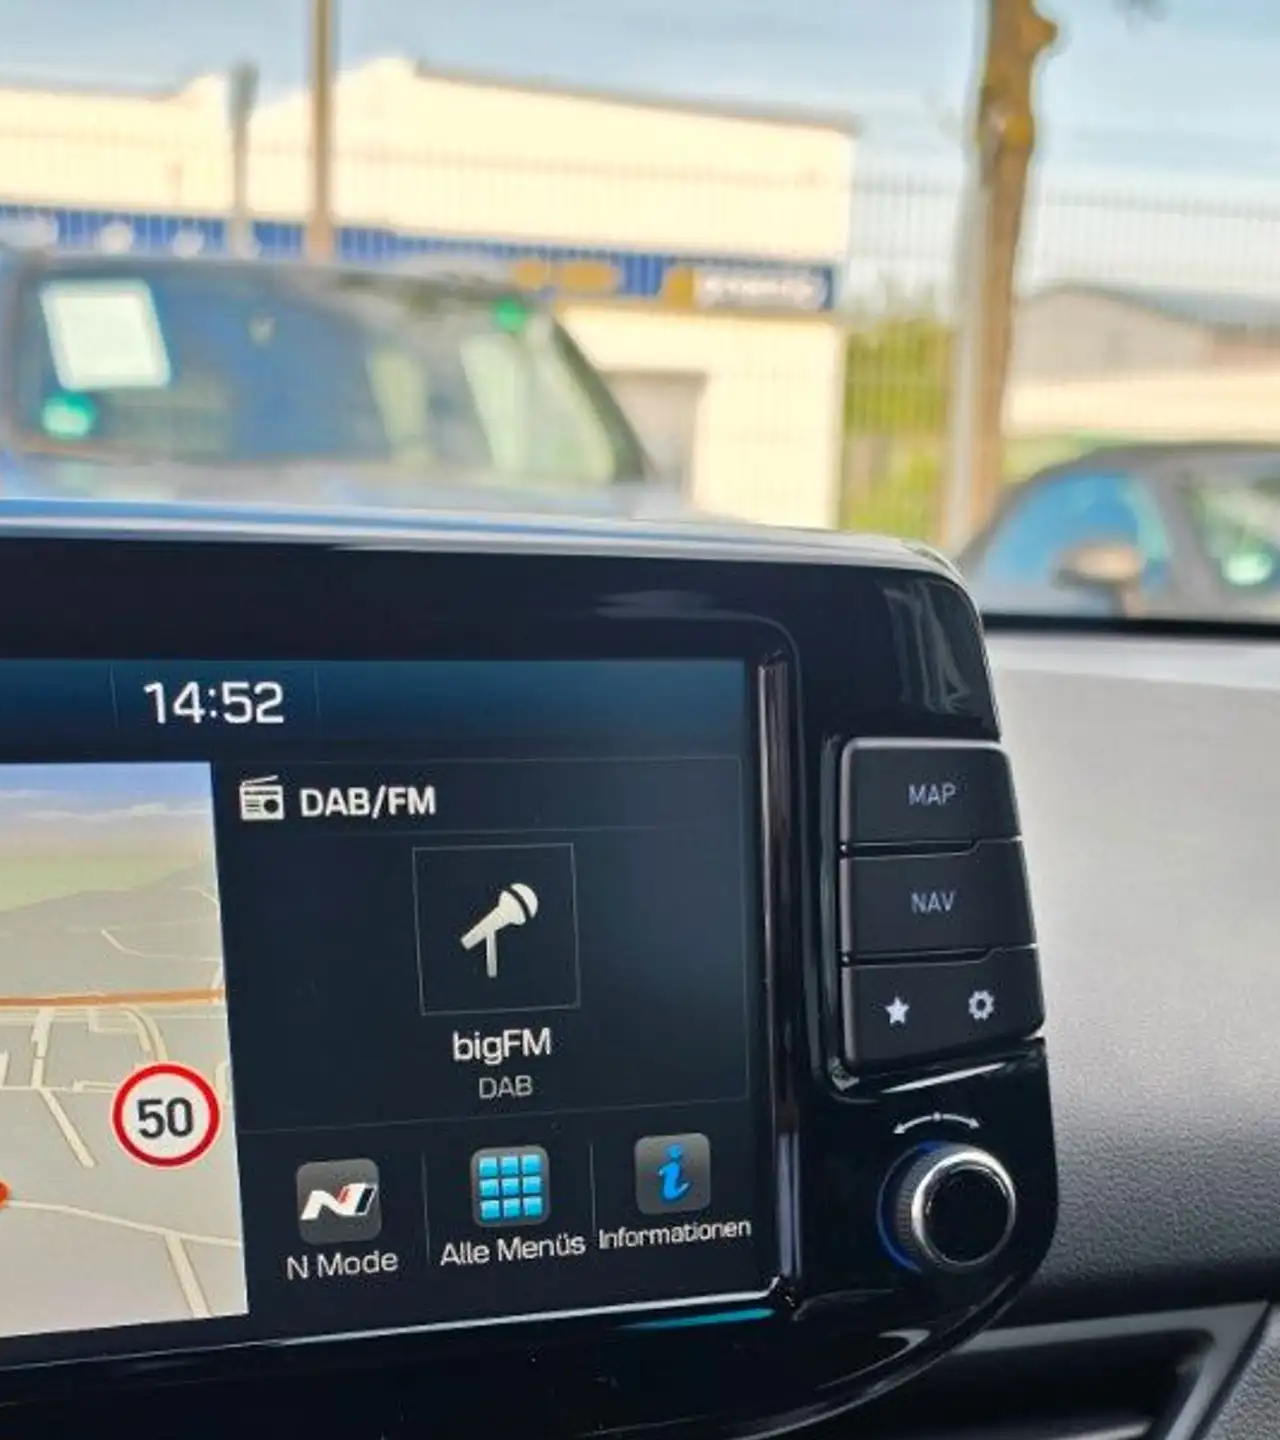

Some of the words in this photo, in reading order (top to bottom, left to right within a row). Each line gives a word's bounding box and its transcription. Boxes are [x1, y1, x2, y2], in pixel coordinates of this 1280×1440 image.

[143, 680, 285, 725] 14:52
[300, 784, 437, 819] DAB/FM
[908, 783, 957, 805] MAP
[911, 891, 957, 913] NAV
[452, 1026, 553, 1066] bigFM
[478, 1074, 533, 1099] DAB
[136, 1096, 194, 1139] 50
[598, 1218, 752, 1249] Informationen
[286, 1256, 309, 1280] N
[316, 1250, 399, 1277] Mode
[440, 1242, 490, 1267] Alle
[497, 1233, 586, 1262] Menüs
